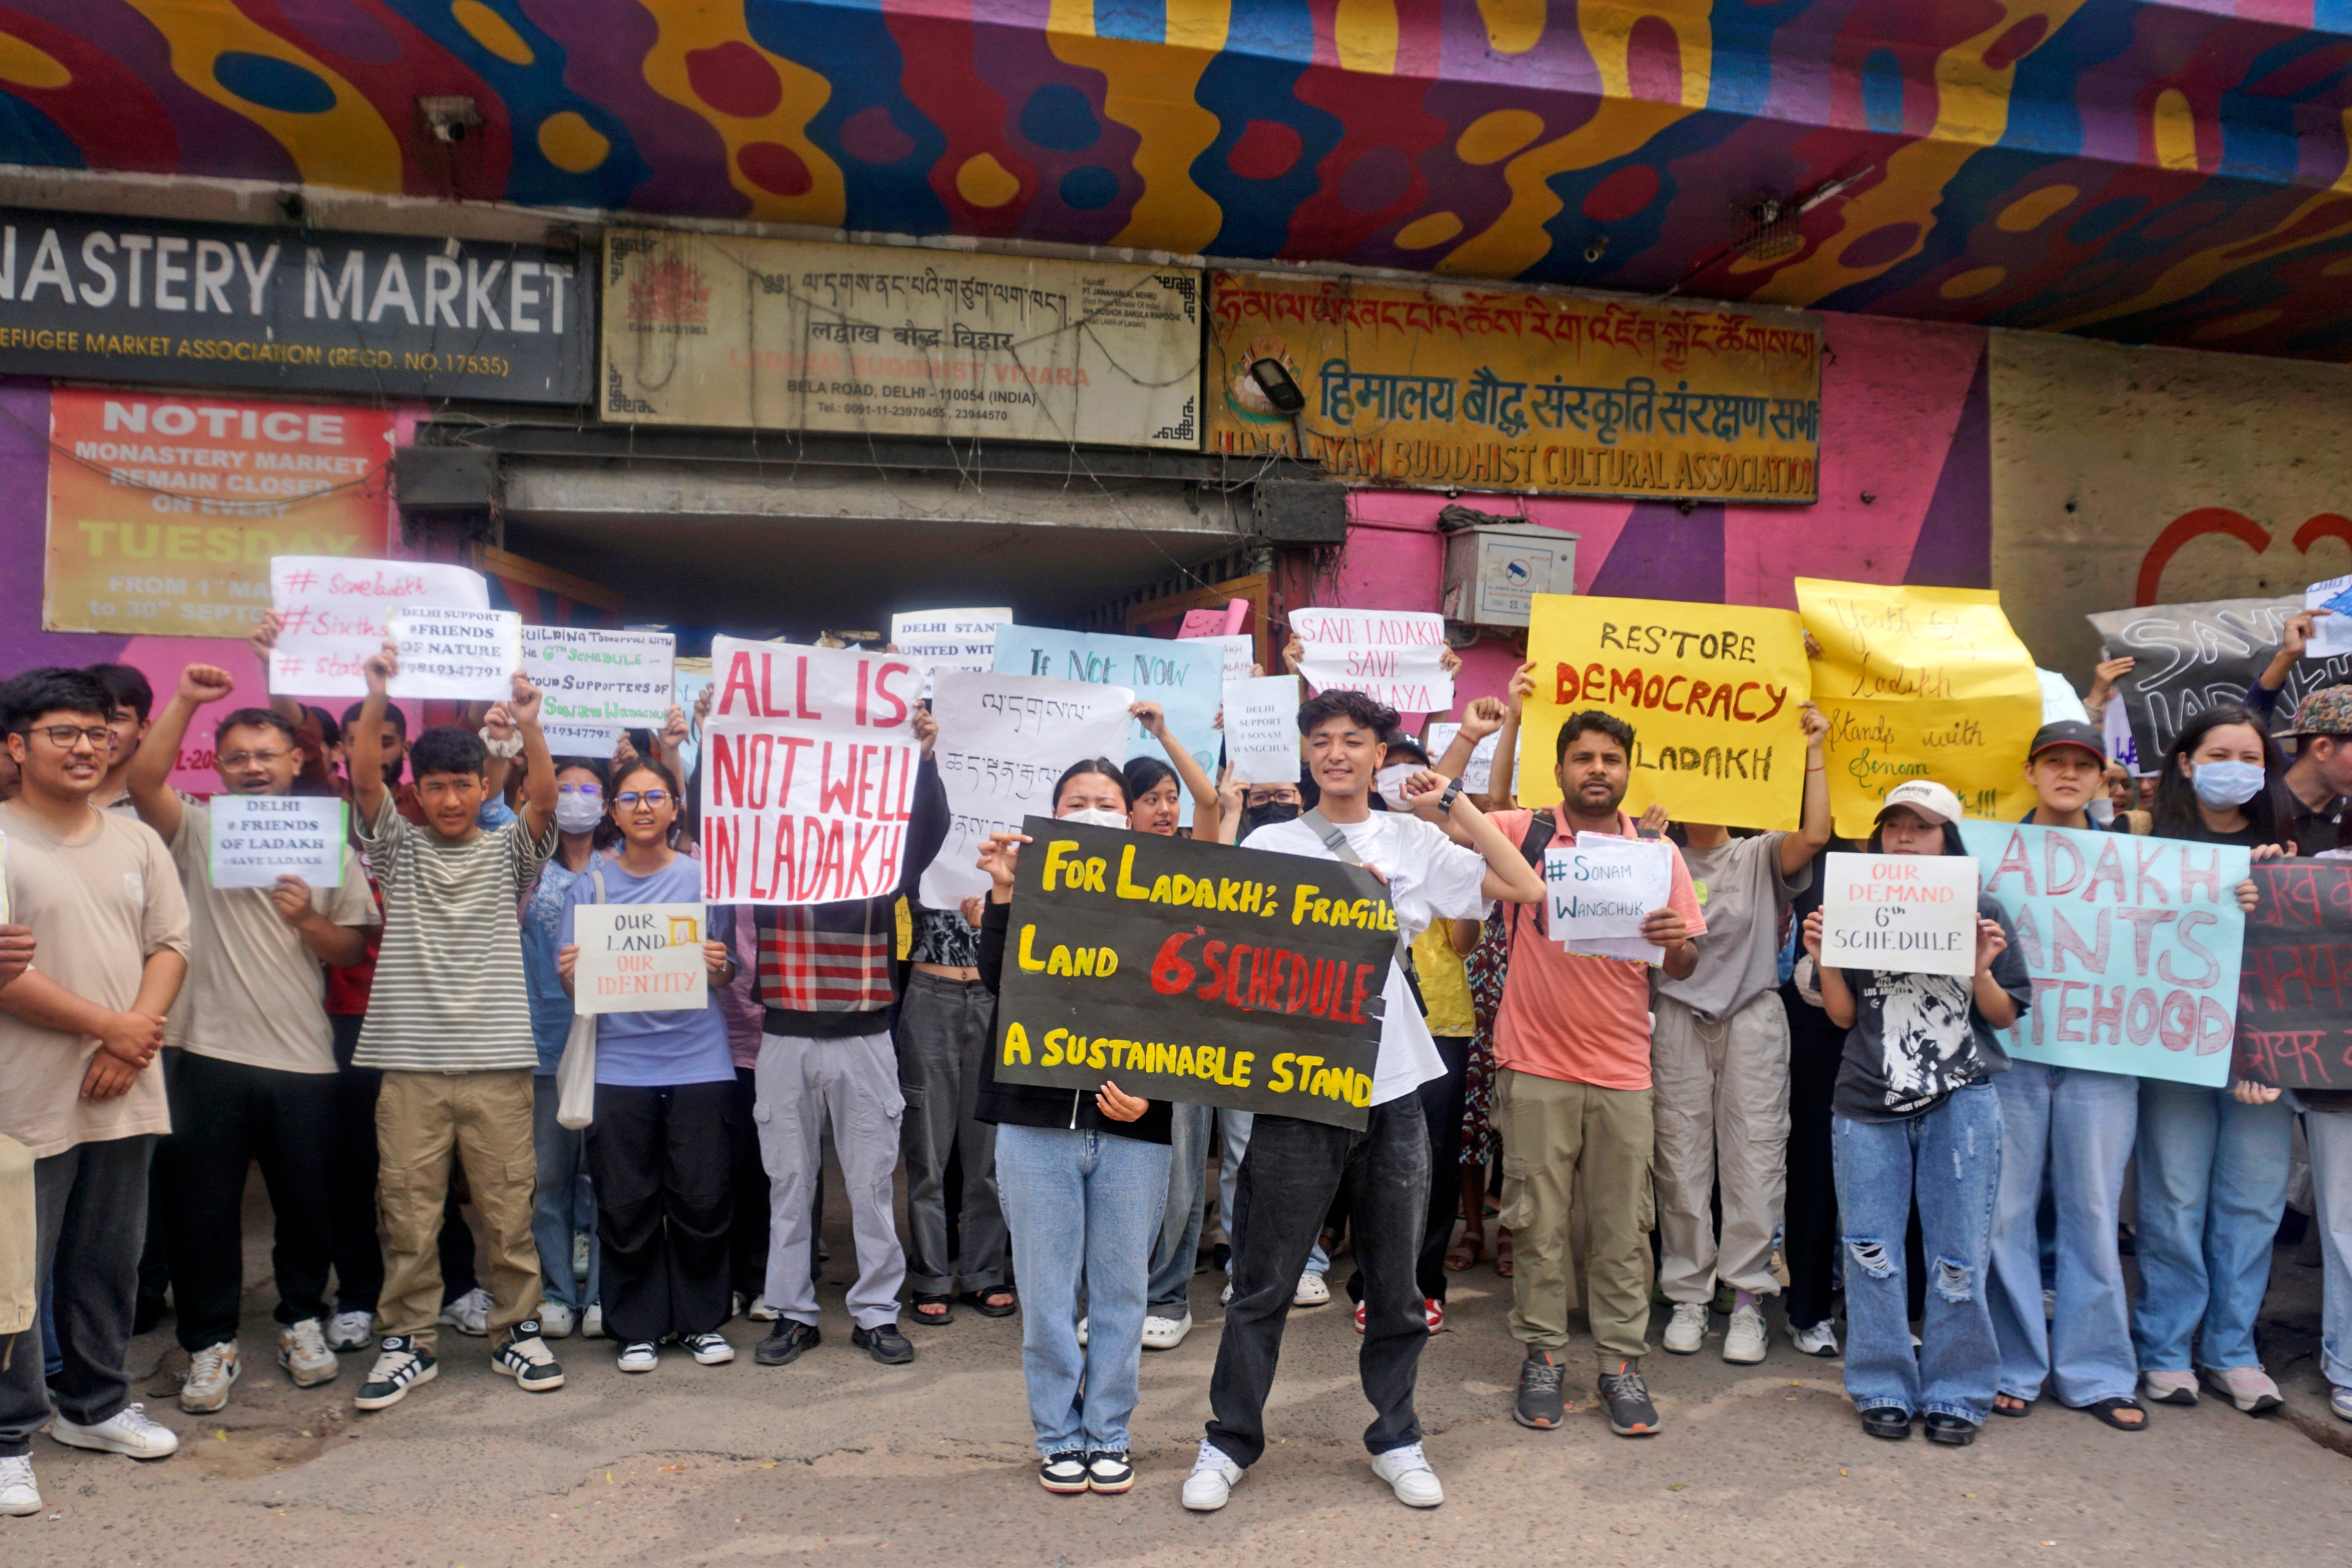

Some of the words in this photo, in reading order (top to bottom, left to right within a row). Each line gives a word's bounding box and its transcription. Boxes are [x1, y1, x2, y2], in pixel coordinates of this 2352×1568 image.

[304, 248, 573, 333] MARKET
[1093, 288, 1134, 298] JAWAHARLAL
[1136, 291, 1157, 300] NEHRU
[1100, 317, 1117, 326] LAMA
[1124, 309, 1149, 319] BAKULA
[1150, 311, 1181, 322] RINPOCHE
[953, 322, 1014, 351] विहार
[86, 333, 171, 356] MARKET
[177, 339, 321, 365] ASSOCIATION
[328, 347, 397, 369] (REGD.
[730, 348, 841, 372] LADAKH
[849, 354, 984, 380] BUDDHIST
[992, 363, 1089, 387] VIHARA
[787, 381, 828, 394] BELA
[831, 383, 877, 398] ROAD,
[882, 385, 926, 399] DELHI
[939, 387, 985, 402] 110054
[989, 391, 1037, 407] (INDIA)
[1319, 358, 1460, 426] हिमालय
[1531, 375, 1655, 444] संस्कृति
[1659, 380, 1769, 442] संरक्षण
[103, 401, 344, 445] NOTICE
[75, 441, 248, 469] MONASTERY
[254, 452, 368, 475] MARKET
[1393, 439, 1536, 483] BUDDHIST
[1543, 445, 1669, 489] CULTURAL
[1675, 451, 1816, 495] ASSOCIATION
[110, 467, 218, 491] REMAIN
[225, 474, 334, 497] CLOSED
[152, 495, 192, 513] ON
[201, 498, 291, 519] EVERY
[77, 520, 360, 565] TUESDAY
[109, 574, 186, 595] FROM
[229, 581, 272, 599] MA
[89, 598, 116, 616] to
[180, 602, 266, 622] SEPTE
[401, 608, 441, 618] DELHI
[444, 609, 502, 622] SUPPORT
[409, 623, 495, 639] #FRIENDS
[902, 623, 947, 633] DELHI
[954, 622, 1004, 633] STAN
[1301, 617, 1358, 644] SAVE
[1366, 620, 1443, 646] LADAKH
[401, 641, 424, 653] OF
[429, 642, 501, 657] NATURE
[901, 645, 958, 656] UNITED
[964, 645, 995, 655] WIT
[1600, 622, 1756, 664] RESTORE
[1031, 648, 1051, 676] If
[1068, 649, 1117, 685] Not
[1134, 654, 1190, 687] Now
[1346, 650, 1402, 678] SAVE
[1852, 651, 1962, 699] Ladakh
[654, 684, 669, 694] OF
[717, 651, 822, 720] ALL
[855, 659, 910, 728] IS
[1555, 661, 1788, 723] DEMOCRACY
[1246, 705, 1275, 714] DELHI
[542, 725, 611, 739] 819347791
[1239, 717, 1282, 728] SUPPORT
[1923, 719, 1986, 747] with
[1247, 732, 1282, 740] SONAM
[1233, 744, 1290, 754] WANGCHUK
[1635, 741, 1773, 782] LADAKH
[713, 733, 814, 810] NOT
[819, 741, 911, 822] WELL
[1849, 747, 1931, 789] Sonam
[246, 800, 301, 812] DELHI
[241, 820, 319, 832] FRIENDS
[221, 839, 242, 849] OF
[247, 839, 325, 850] LADAKH
[267, 856, 323, 865] LADAKH
[705, 814, 740, 900] IN
[750, 814, 901, 901] LADAKH
[1042, 839, 1106, 893] FOR
[1546, 859, 1567, 882] #
[1574, 855, 1632, 881] SONAM
[1978, 826, 2221, 905] ADAKH
[1872, 863, 1921, 881] OUR
[1849, 883, 1955, 903] DEMAND
[1556, 895, 1645, 919] WANGCHUK
[1875, 906, 1906, 927] 6th
[614, 913, 657, 931] OUR
[606, 933, 666, 952] LAND
[1832, 929, 1962, 951] SCHEDULE
[2012, 903, 2222, 990] ANTS
[617, 955, 655, 972] OUR
[1017, 924, 1119, 978] LAND
[1197, 939, 1375, 1024] SCHEDULE
[596, 971, 697, 996] IDENTITY
[1863, 987, 1877, 997] LOS
[2011, 977, 2233, 1057] TEHOOD
[1003, 1021, 1031, 1067] A
[1040, 1028, 1255, 1088] SUSTAINABLE
[1268, 1052, 1373, 1108] STAND
